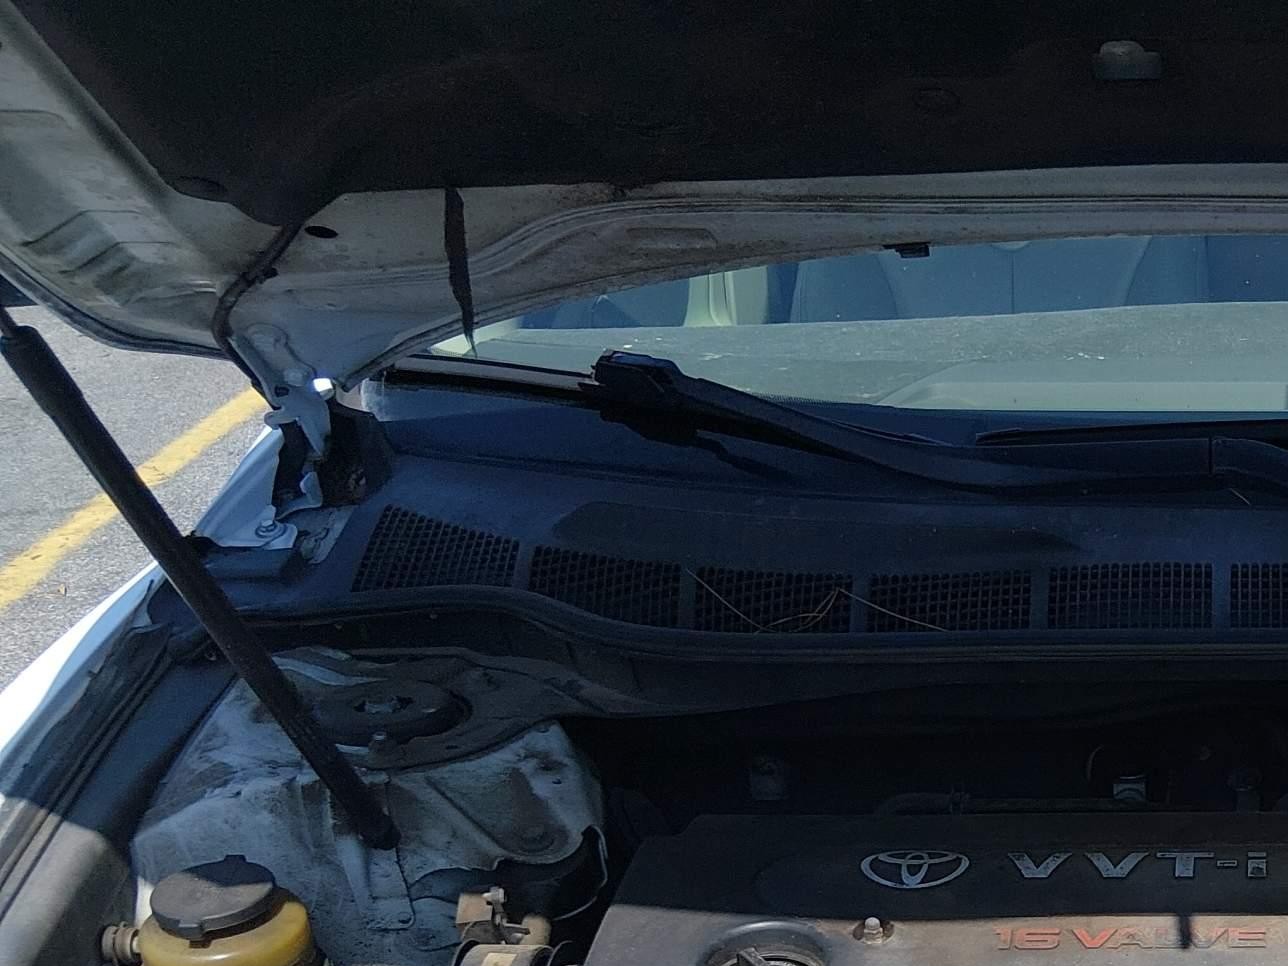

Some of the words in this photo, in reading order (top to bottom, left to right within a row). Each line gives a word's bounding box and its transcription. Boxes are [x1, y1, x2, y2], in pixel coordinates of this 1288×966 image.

[1007, 852, 1267, 879] VVT-i
[993, 927, 1061, 950] 16
[1070, 927, 1267, 950] VALVE
